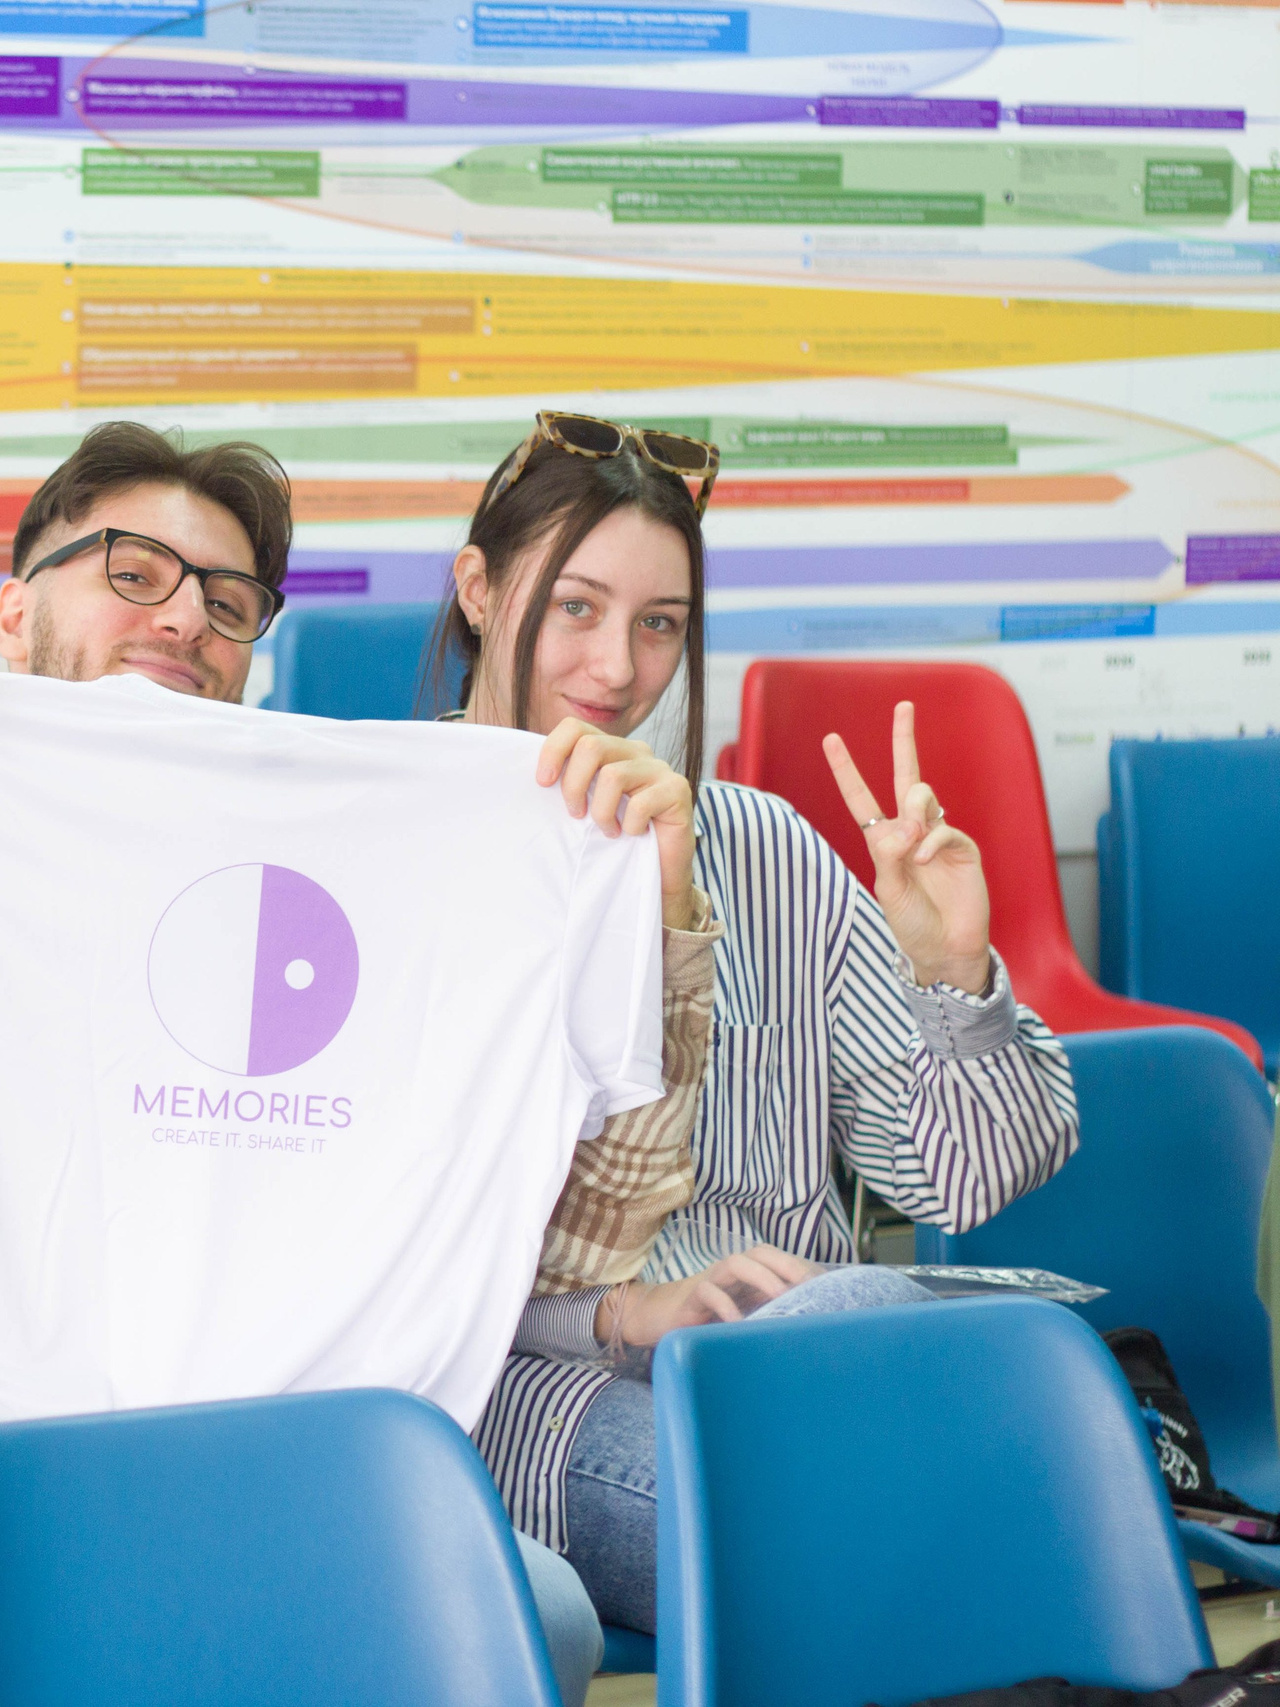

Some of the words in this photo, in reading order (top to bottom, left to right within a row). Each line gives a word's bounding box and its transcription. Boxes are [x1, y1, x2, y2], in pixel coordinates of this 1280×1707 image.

[133, 1083, 352, 1129] MEMORIES
[152, 1127, 220, 1148] CREATE
[225, 1132, 242, 1149] IT.
[247, 1134, 306, 1153] SHARE
[311, 1139, 327, 1154] IT
